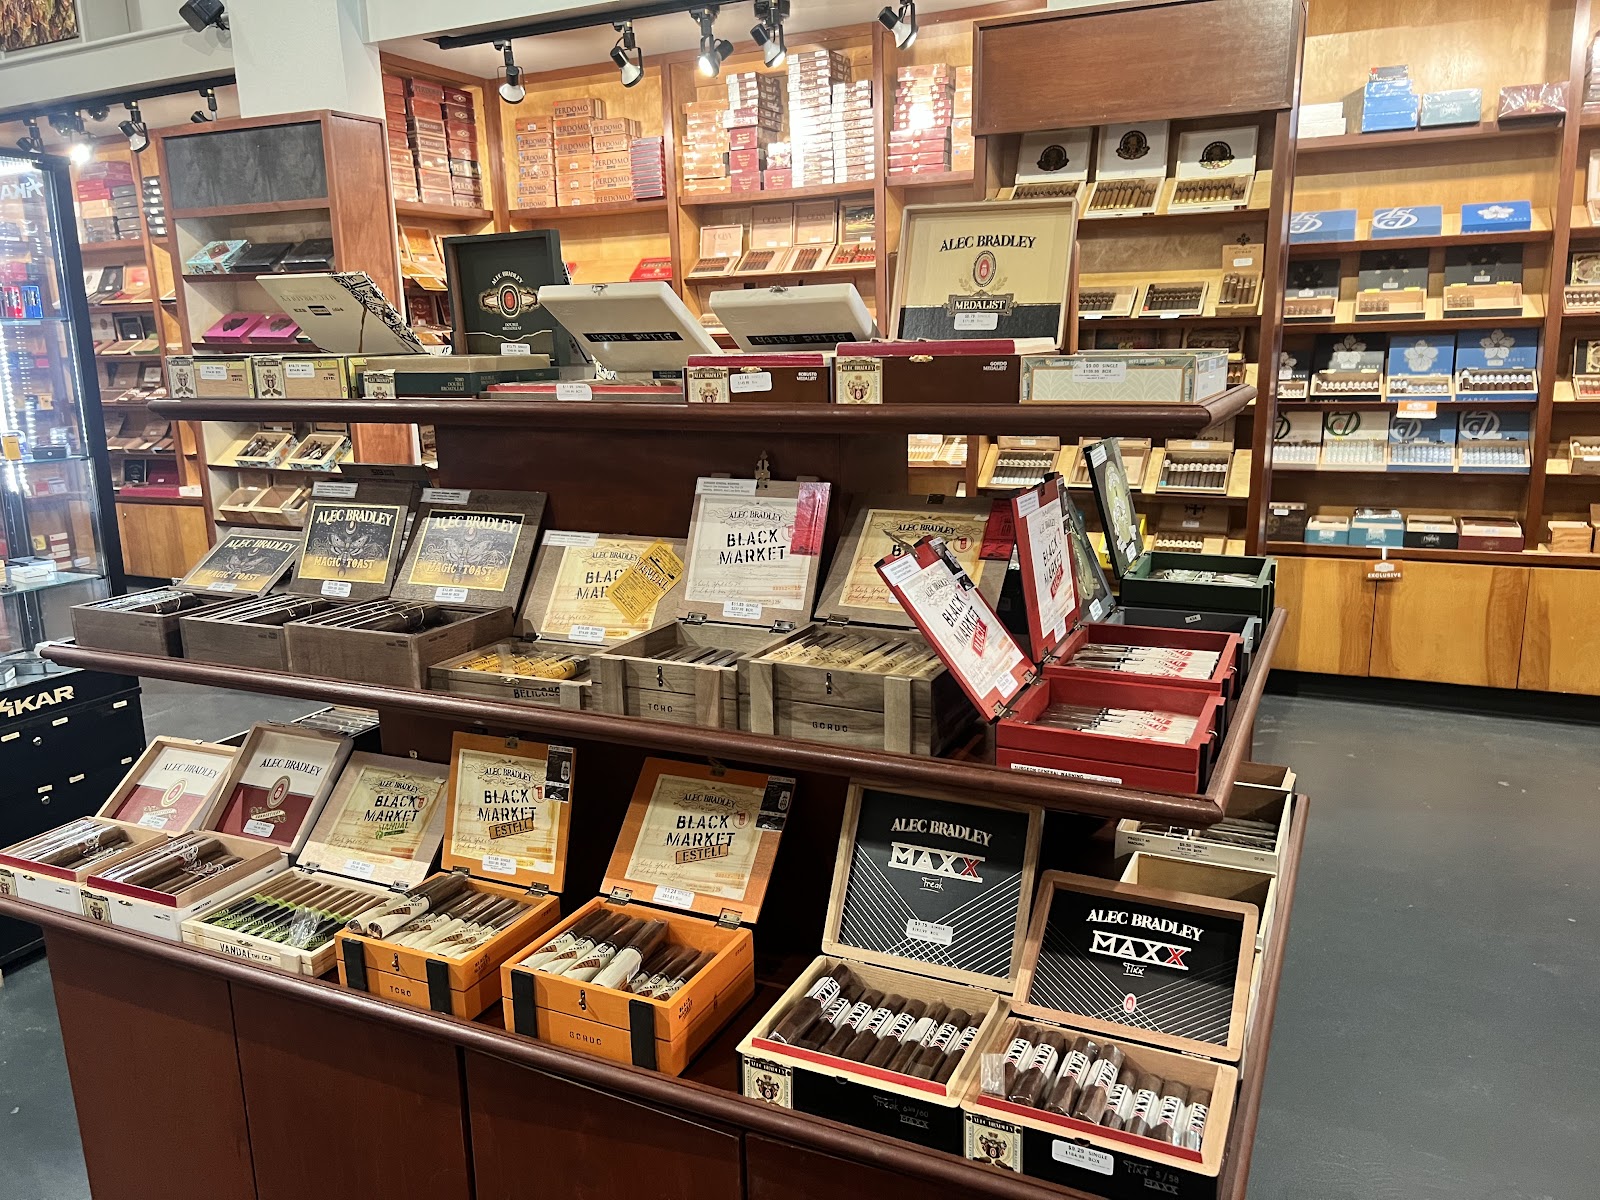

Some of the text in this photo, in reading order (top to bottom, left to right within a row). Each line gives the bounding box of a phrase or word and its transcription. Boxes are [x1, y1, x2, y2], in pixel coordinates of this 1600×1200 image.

[554, 105, 588, 115] PERDOMO
[594, 124, 623, 132] PERDOMO
[595, 157, 629, 166] PERDOMO
[595, 175, 630, 184] PERDOMO
[596, 194, 631, 203] PERDOMO
[939, 234, 1037, 252] ALEC BRADLEY
[502, 270, 524, 284] BRADLEY
[955, 300, 1005, 310] MEDALIST
[316, 509, 394, 527] ALEC BRADLEY
[729, 510, 783, 522] ALEC BRADLEY
[432, 515, 518, 534] ALEC BRADLEY
[897, 523, 957, 535] ALEC BRADLEY
[225, 538, 297, 553] ALEC BRADLEY
[727, 529, 778, 547] BLACK
[592, 551, 638, 561] ALEC BRADLEY
[719, 546, 787, 565] MARKET
[1042, 536, 1060, 567] BLACK
[314, 556, 375, 569] MAGIC TOAST
[426, 561, 495, 576] MAGIC TOAST
[205, 569, 261, 582] MAGIC TOAST
[585, 569, 624, 584] BLAC
[942, 593, 967, 628] BLACK
[954, 606, 980, 648] MARKET
[812, 722, 848, 733] GORDO
[163, 763, 220, 779] ALEC BRADLEY
[260, 758, 323, 777] ALEC BRADLEY
[484, 768, 532, 782] ALEC BRADLEY
[1037, 768, 1059, 776] GENERAL
[380, 780, 420, 794] ALEC BRADLEY
[375, 795, 419, 808] BLACK
[484, 789, 529, 804] BLACK
[683, 793, 737, 808] ALEC BRADLEY
[363, 809, 420, 822] MARKET
[477, 806, 537, 823] MARKET
[676, 815, 731, 830] BLACK
[665, 832, 736, 847] MARKET
[891, 818, 993, 848] ALEC BRADLEY
[682, 846, 723, 862] ESTELI
[888, 842, 986, 884] MAXX
[922, 876, 944, 892] Freak
[1086, 909, 1204, 942] ALEC BRADLEY
[219, 942, 250, 958] VANDAL
[1089, 930, 1192, 971] MAXX
[389, 985, 412, 998] TORO
[813, 977, 840, 1008] MAXX
[846, 1002, 871, 1029] MAXX
[866, 1008, 891, 1034] MAXX
[888, 1012, 915, 1041] MAXX
[569, 1031, 603, 1046] GORDO
[932, 1023, 957, 1051] MAXX
[1005, 1038, 1030, 1067] MAXX
[1031, 1044, 1055, 1072] MAXX
[1065, 1051, 1088, 1083] MAXX
[1097, 1060, 1117, 1096] MAXX
[1134, 1089, 1154, 1121] MAXX
[1160, 1096, 1180, 1129] MAXX
[1088, 1151, 1108, 1160] SINGLE
